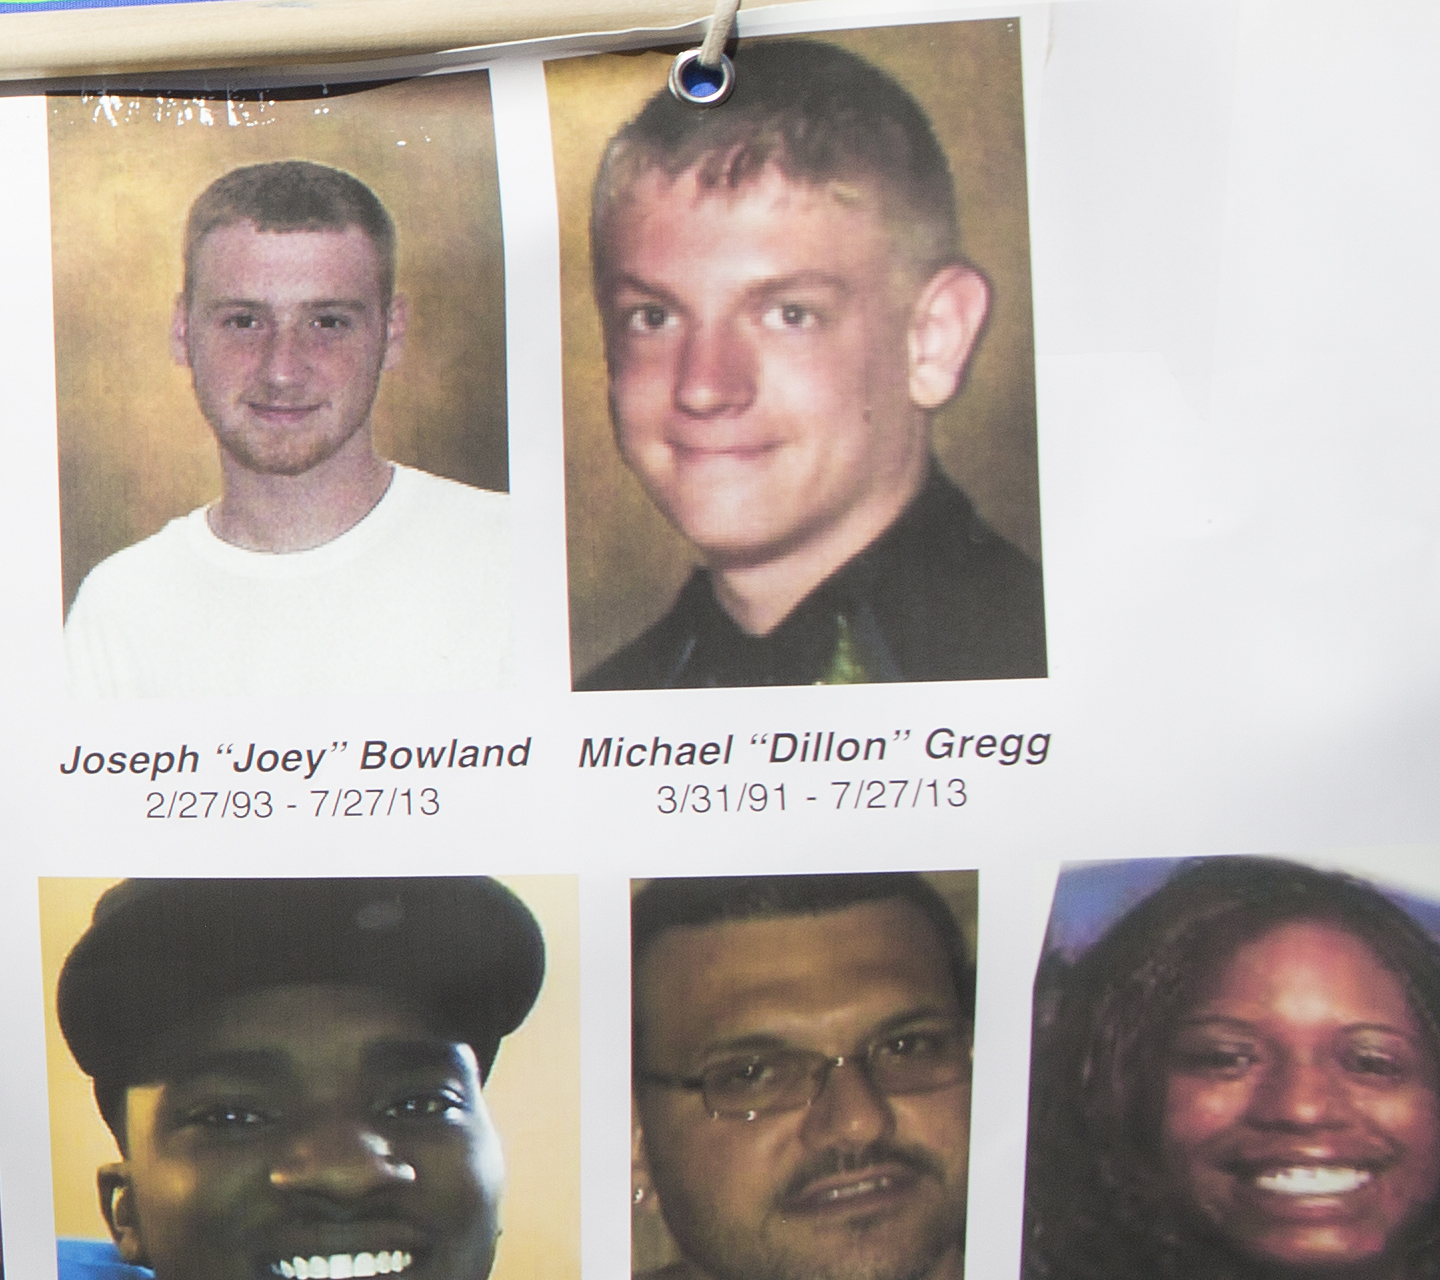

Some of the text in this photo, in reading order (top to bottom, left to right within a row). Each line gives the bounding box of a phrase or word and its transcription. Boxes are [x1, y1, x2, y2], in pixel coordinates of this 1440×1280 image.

[60, 736, 532, 782] Joseph “Joey” Bowland
[579, 727, 1051, 768] Michael “Dillon” Gregg
[146, 790, 273, 819] 2/27/93
[311, 787, 440, 817] 7/27/13
[658, 783, 785, 814] 3/31/91
[831, 778, 967, 809] 7/27/13
